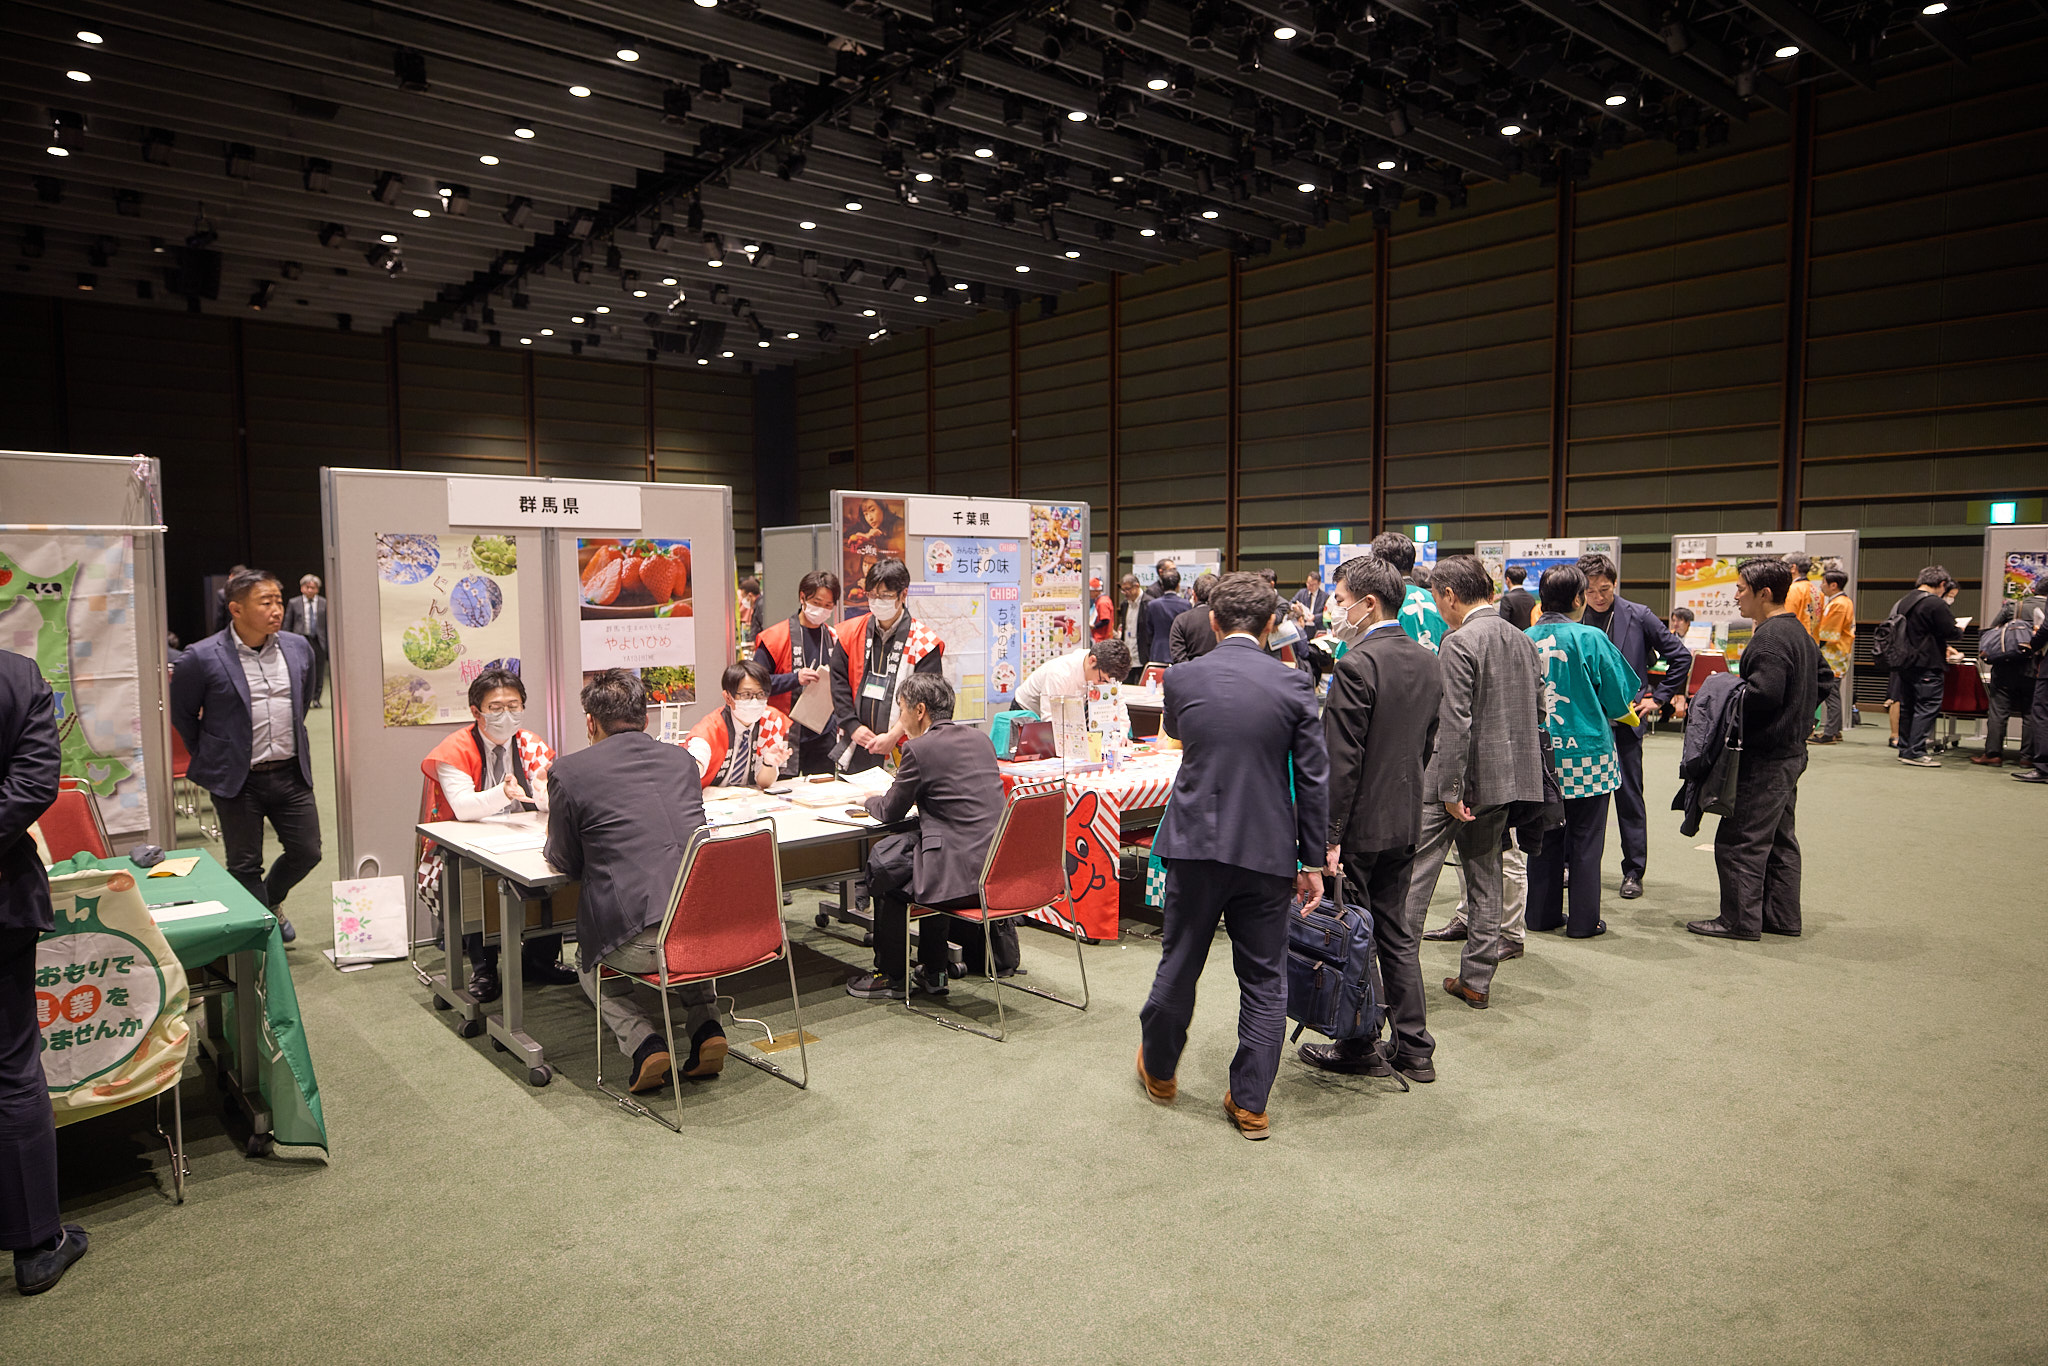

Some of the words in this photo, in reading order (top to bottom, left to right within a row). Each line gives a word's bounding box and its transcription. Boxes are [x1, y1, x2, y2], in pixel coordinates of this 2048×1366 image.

[519, 496, 579, 514] 群馬県
[953, 512, 990, 526] 千葉県
[956, 546, 990, 555] みんな大好き
[999, 543, 1018, 552] CHIBA
[1746, 540, 1773, 549] 宮崎県
[956, 558, 1009, 574] ちばの味
[990, 588, 1017, 600] CHIBA
[998, 608, 1009, 660] ちばの味
[605, 635, 672, 652] やよいひめ
